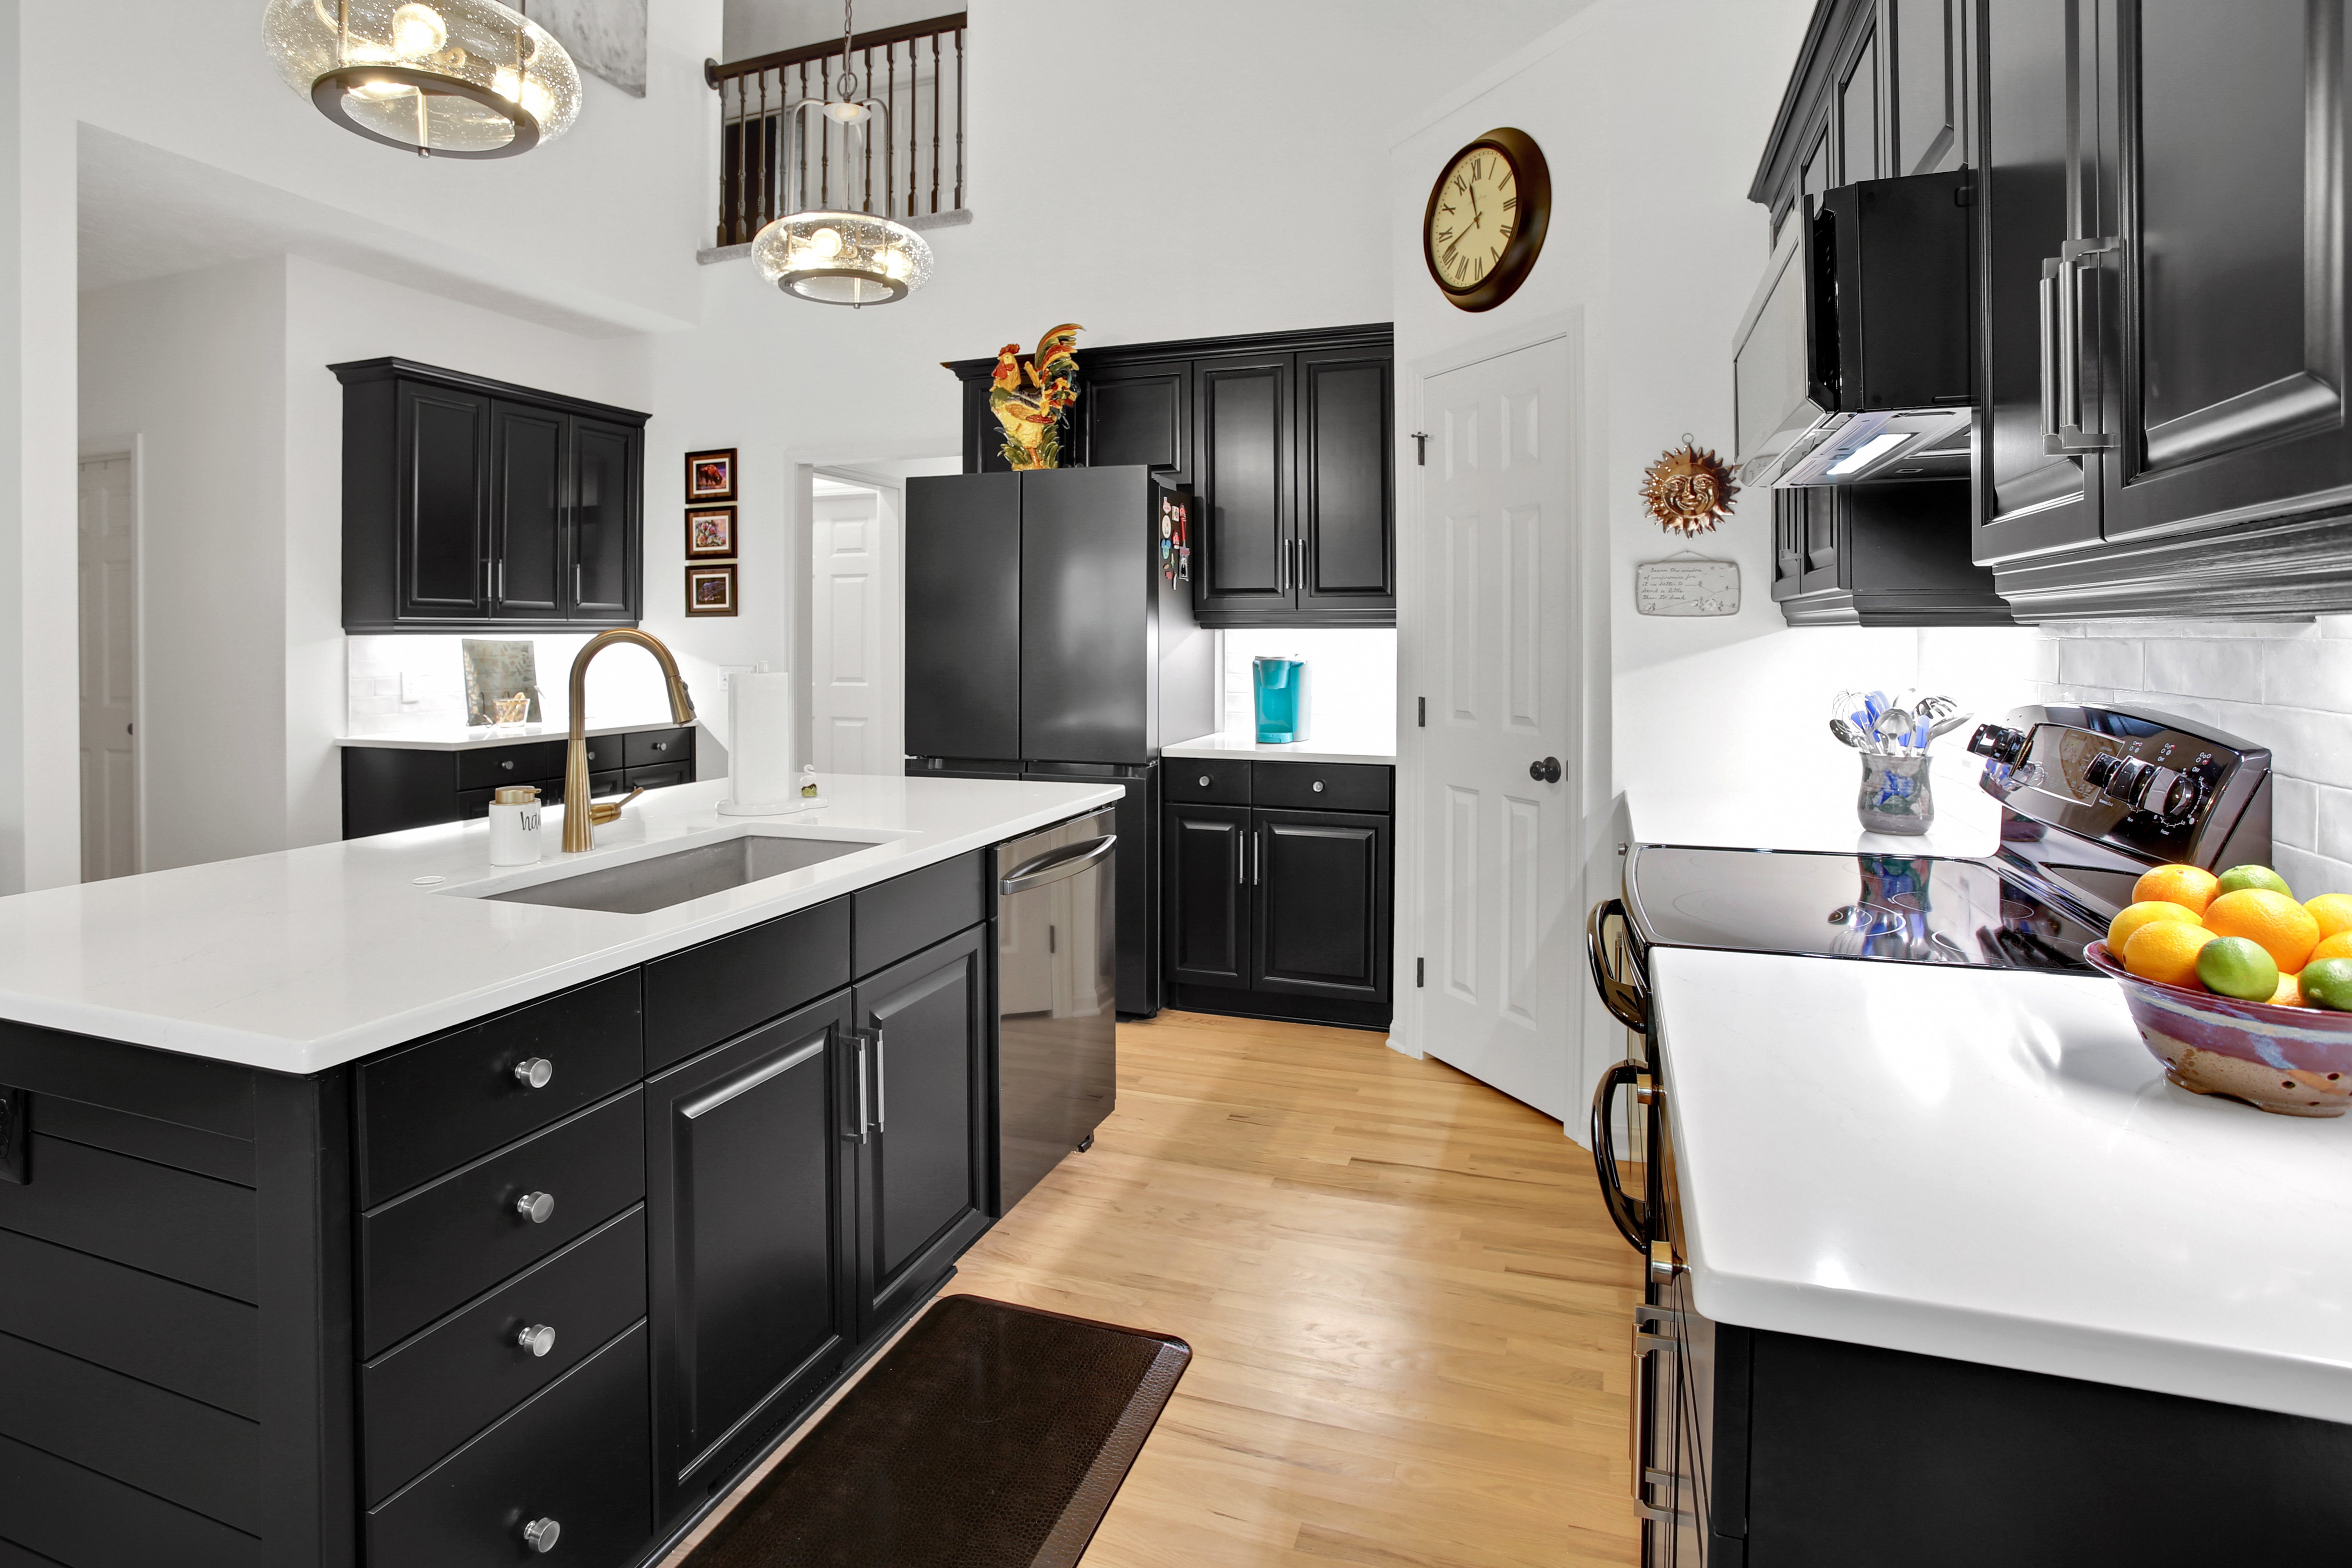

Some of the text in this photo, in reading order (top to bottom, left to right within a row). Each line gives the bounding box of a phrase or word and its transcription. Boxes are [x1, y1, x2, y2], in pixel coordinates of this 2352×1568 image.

[1471, 158, 1481, 183] XII
[1498, 169, 1513, 191] II
[1454, 174, 1467, 196] XI
[1442, 203, 1457, 216] X
[1503, 197, 1517, 212] III
[1439, 226, 1452, 243] IX
[1455, 255, 1469, 282] VII
